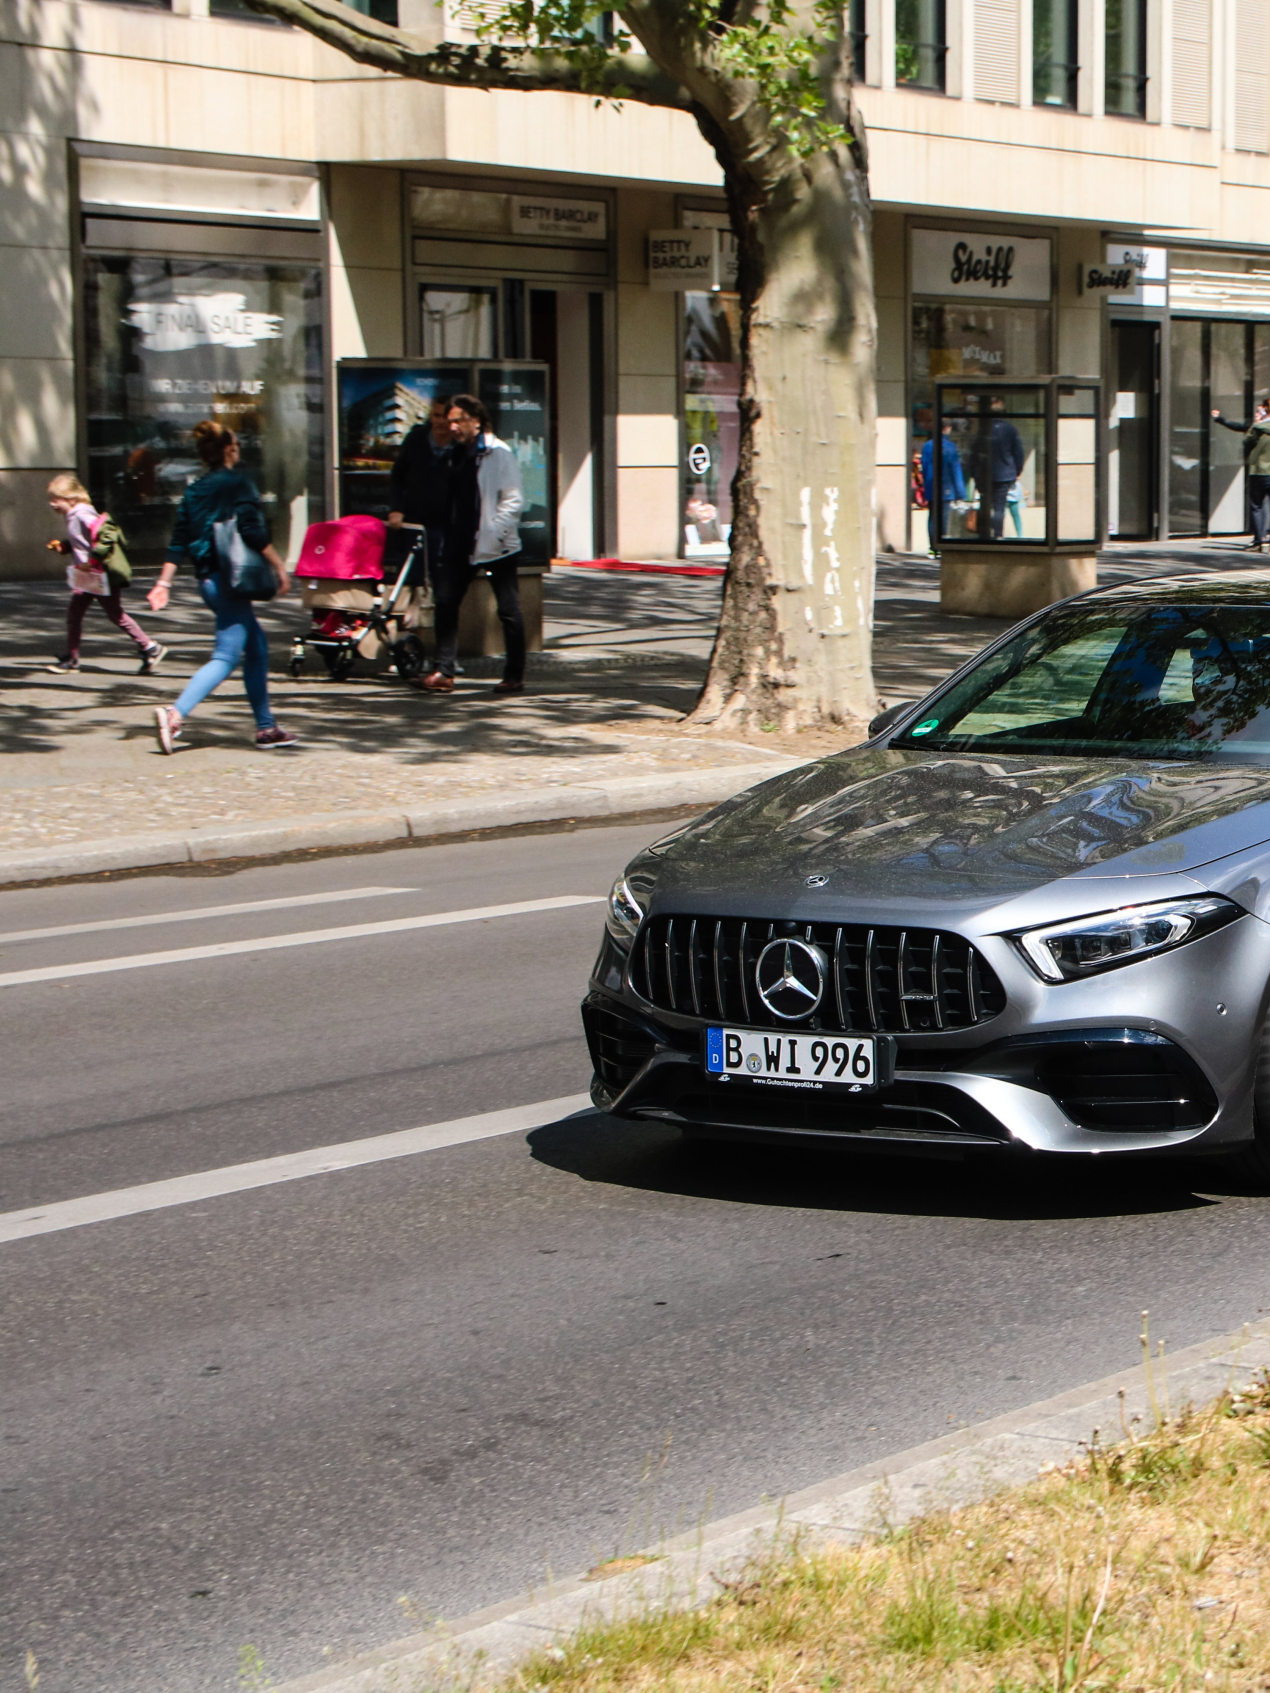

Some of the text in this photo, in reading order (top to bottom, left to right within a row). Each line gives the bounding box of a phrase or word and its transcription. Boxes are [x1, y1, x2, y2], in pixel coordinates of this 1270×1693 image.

[520, 205, 599, 223] BETTY BARCLAY
[652, 239, 691, 253] BETTY
[652, 255, 711, 269] BARCLAY
[951, 241, 1015, 287] Steiff
[1086, 268, 1131, 289] Steiff
[155, 312, 254, 335] FINAL SALE
[712, 1053, 719, 1064] D
[725, 1033, 871, 1079] B WI 996
[752, 1077, 823, 1090] www.Gutachtenprofi24.de
